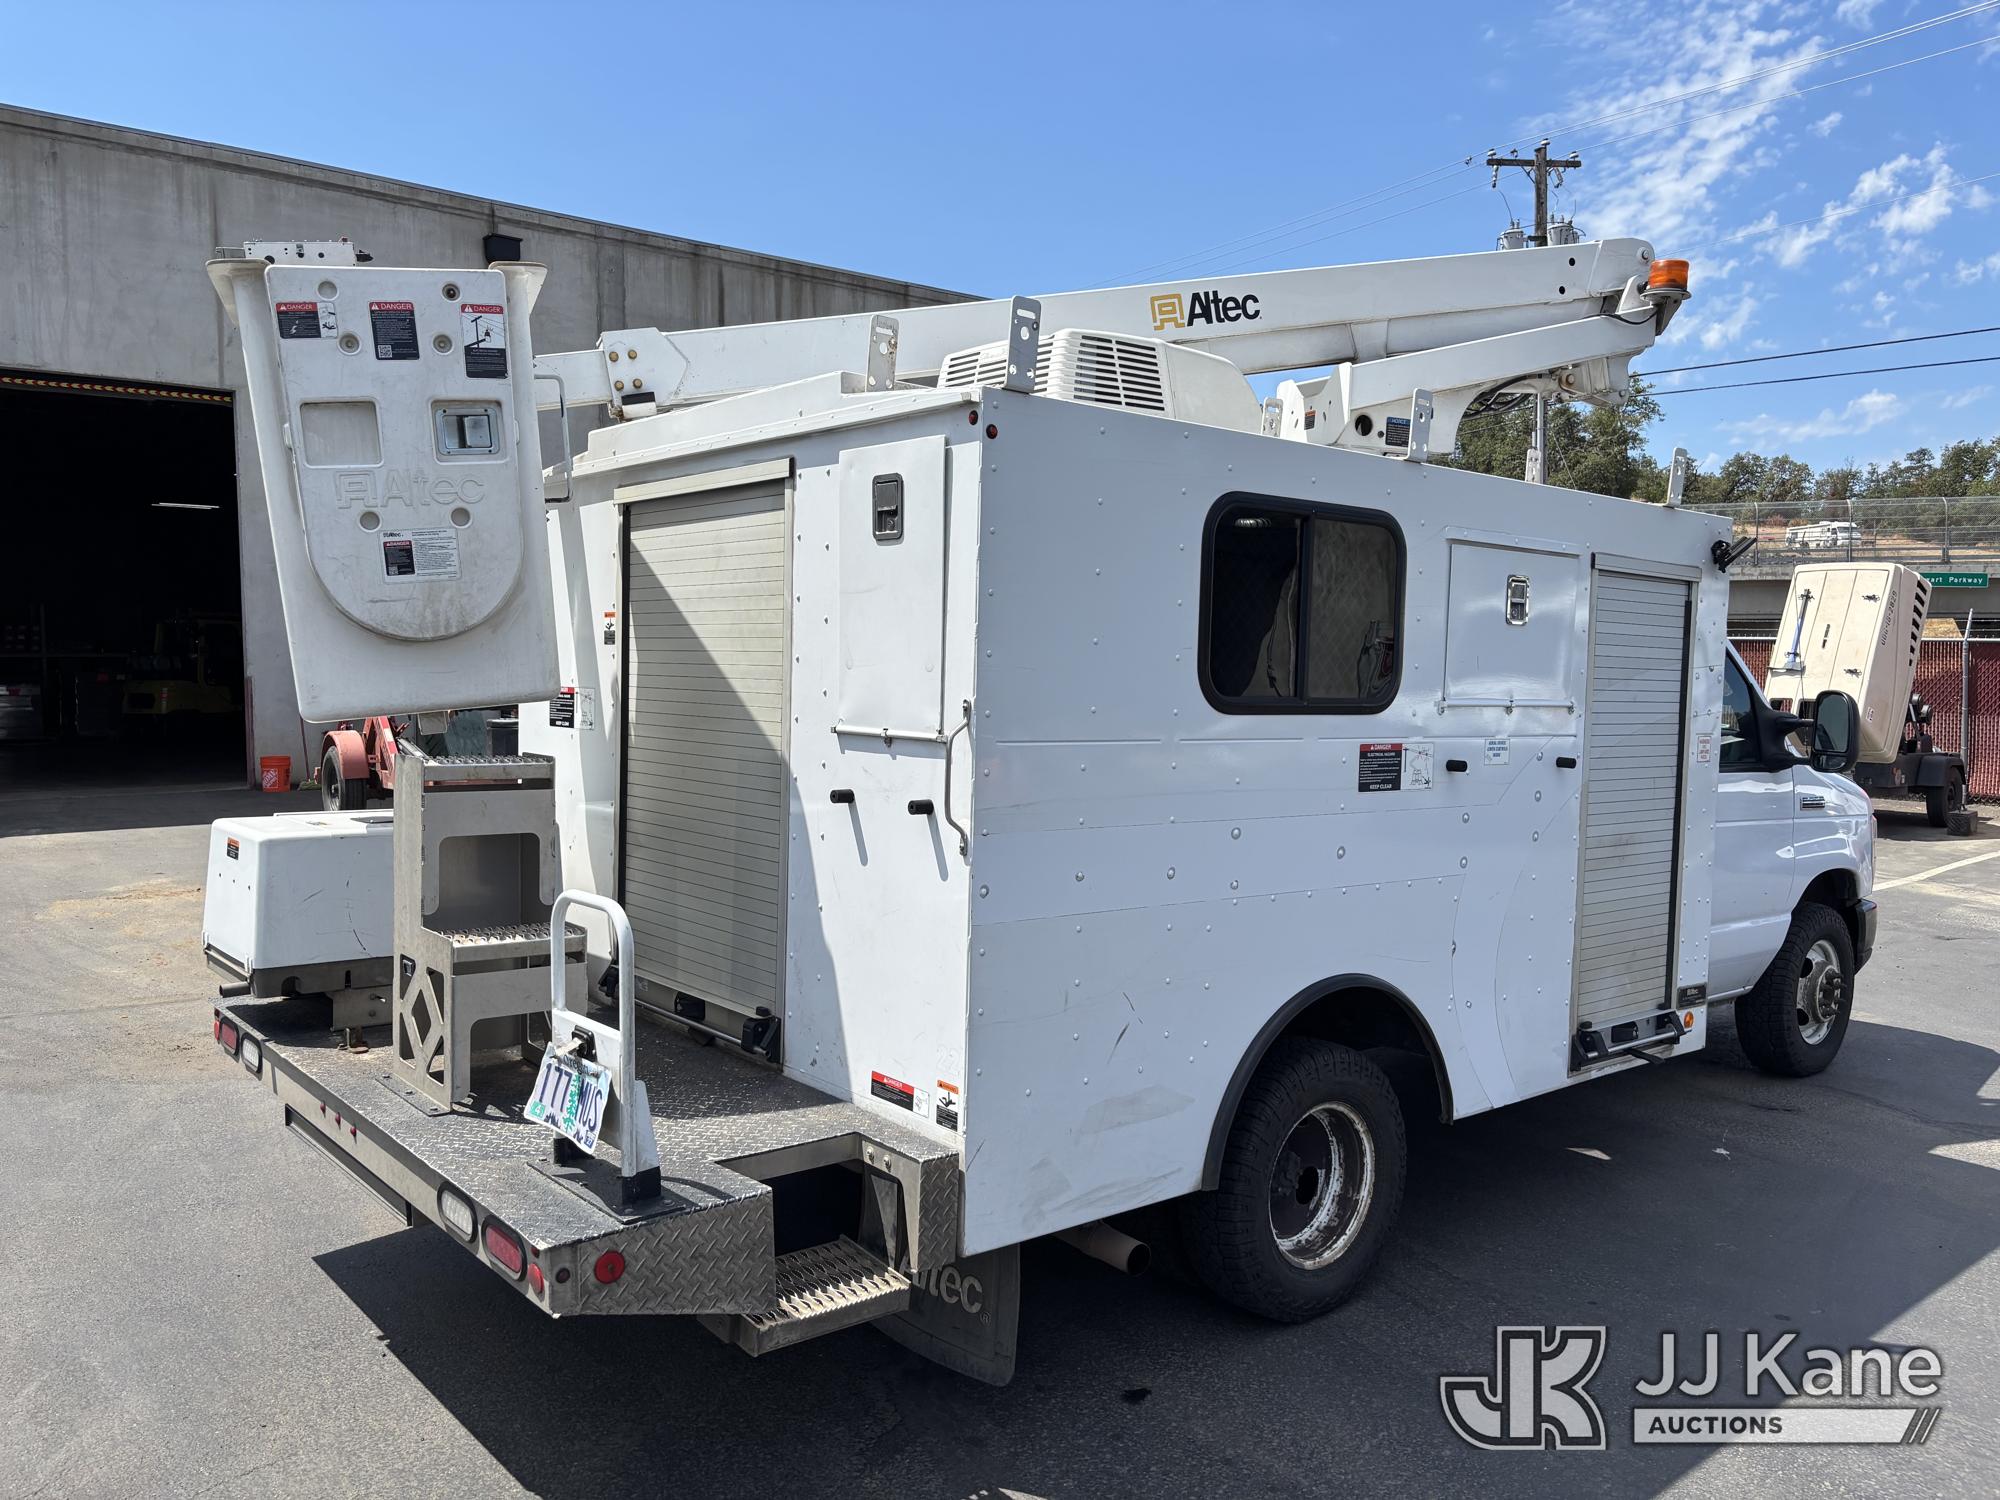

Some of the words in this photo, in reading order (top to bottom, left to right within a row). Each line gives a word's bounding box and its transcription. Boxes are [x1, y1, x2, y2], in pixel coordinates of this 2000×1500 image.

[473, 305, 501, 313] DANGER
[1186, 289, 1262, 327] Altec
[381, 469, 485, 508] Altec
[1948, 576, 1983, 585] Parkway
[539, 1062, 573, 1113] 177
